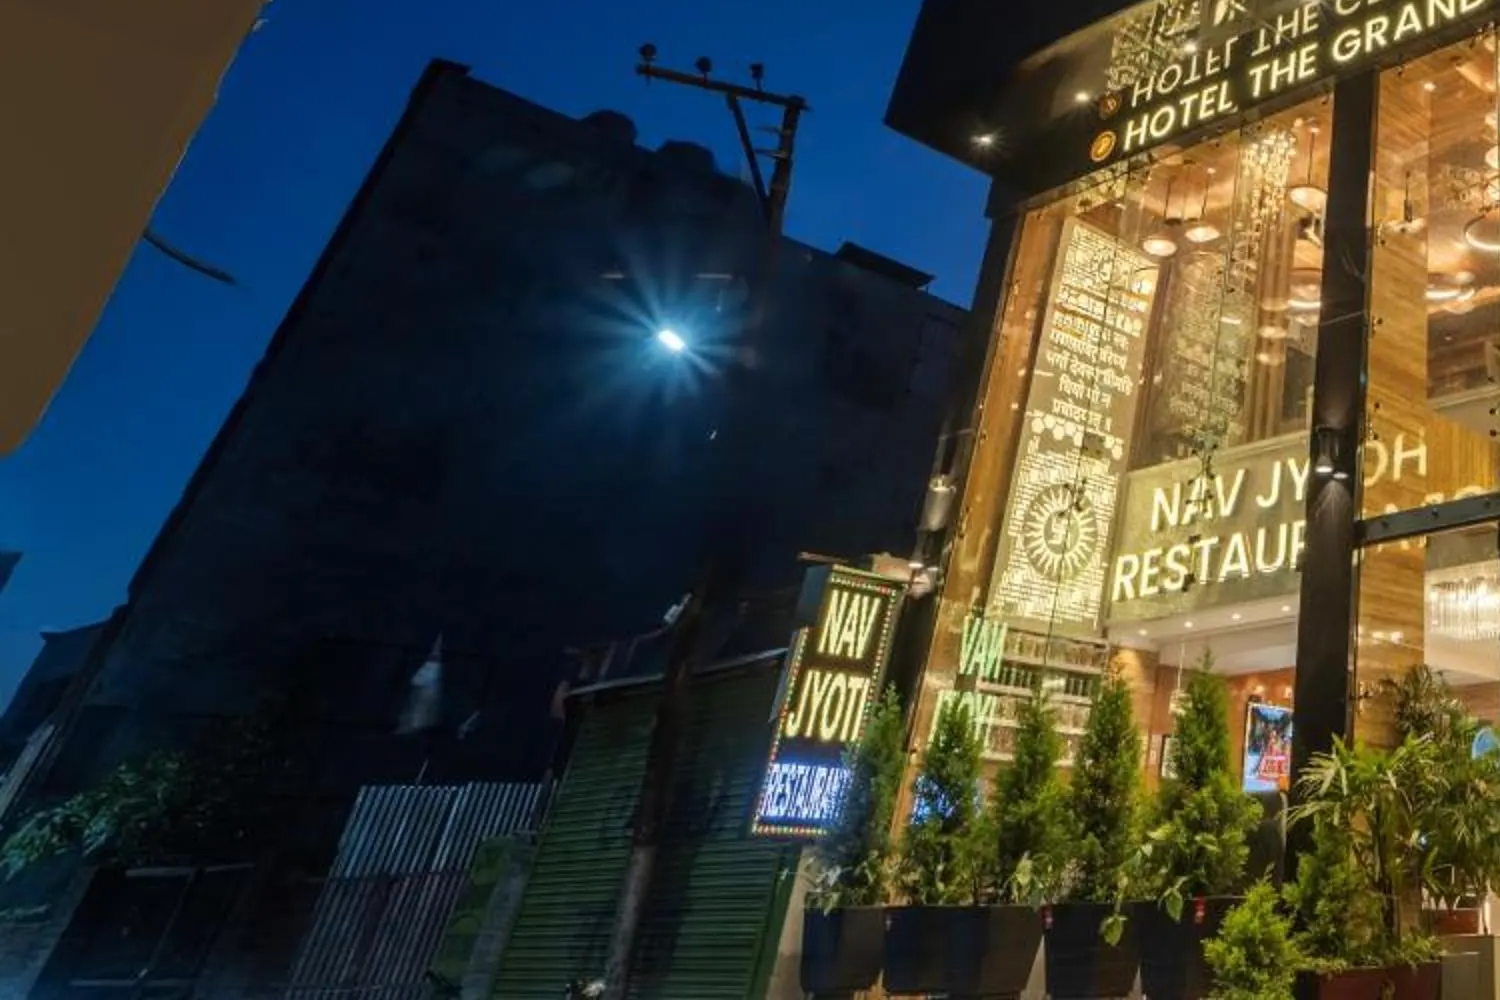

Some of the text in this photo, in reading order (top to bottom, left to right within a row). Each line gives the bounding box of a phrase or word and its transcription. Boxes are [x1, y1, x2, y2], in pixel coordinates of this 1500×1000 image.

[1123, 79, 1235, 152] HOTEL
[1249, 43, 1318, 99] THE
[1151, 469, 1246, 532] NAV
[818, 589, 881, 659] NAV
[785, 672, 871, 742] JYOTI
